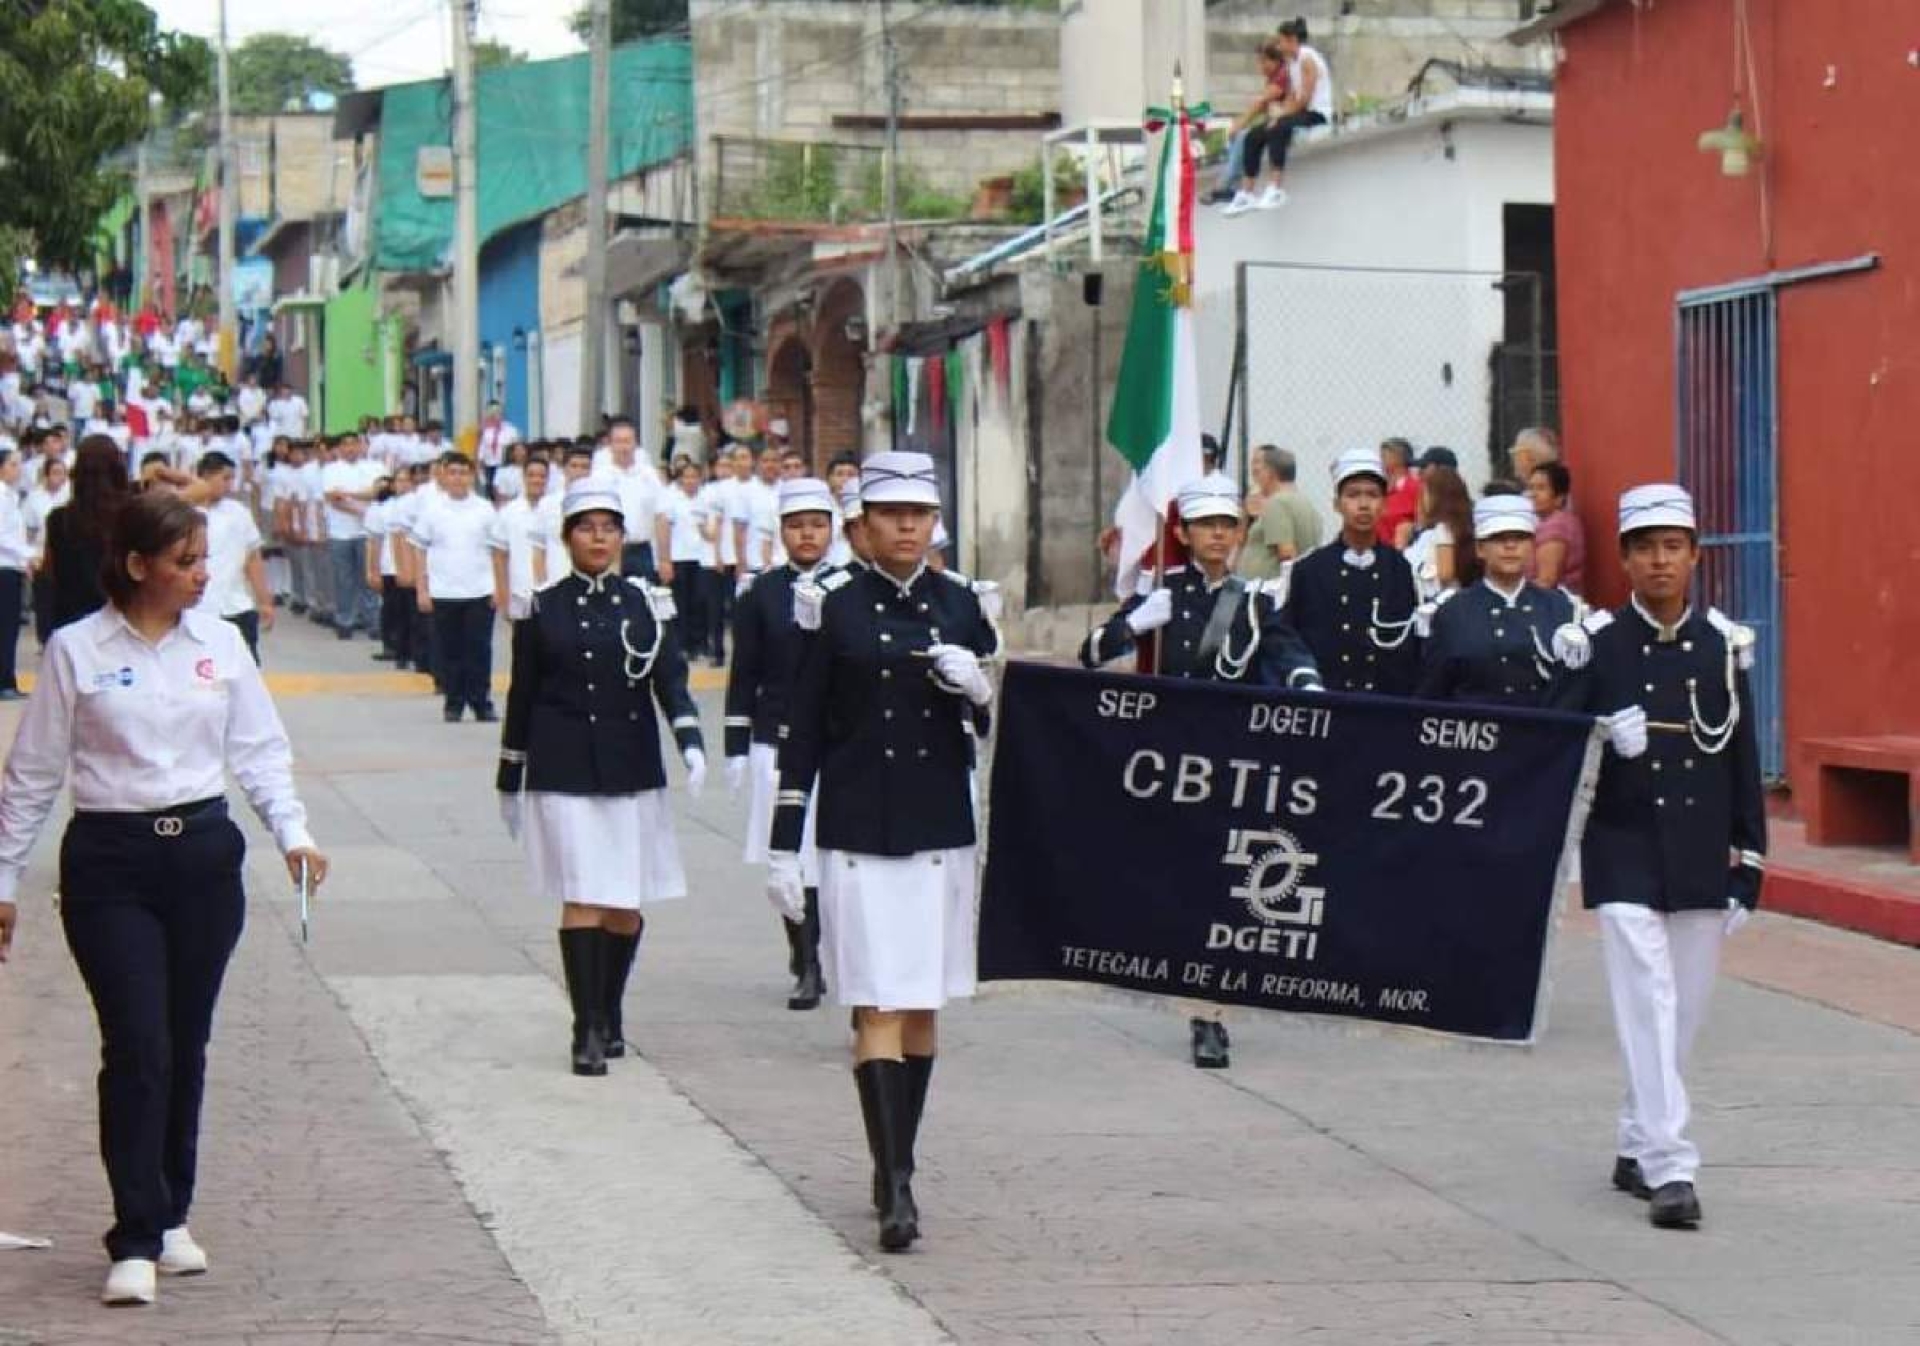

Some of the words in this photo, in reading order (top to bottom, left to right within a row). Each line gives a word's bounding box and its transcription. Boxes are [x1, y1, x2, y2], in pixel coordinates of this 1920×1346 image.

[1097, 689, 1157, 720] SEP
[1249, 703, 1331, 739] DGETI
[1419, 716, 1499, 751] SEMS
[1122, 749, 1319, 815] CBTis
[1371, 771, 1489, 828] 232
[1206, 922, 1318, 960] DGETI
[1061, 945, 1169, 980] TETECALA
[1182, 961, 1215, 987] DE
[1220, 968, 1248, 991] LA
[1378, 988, 1430, 1013] MOR.
